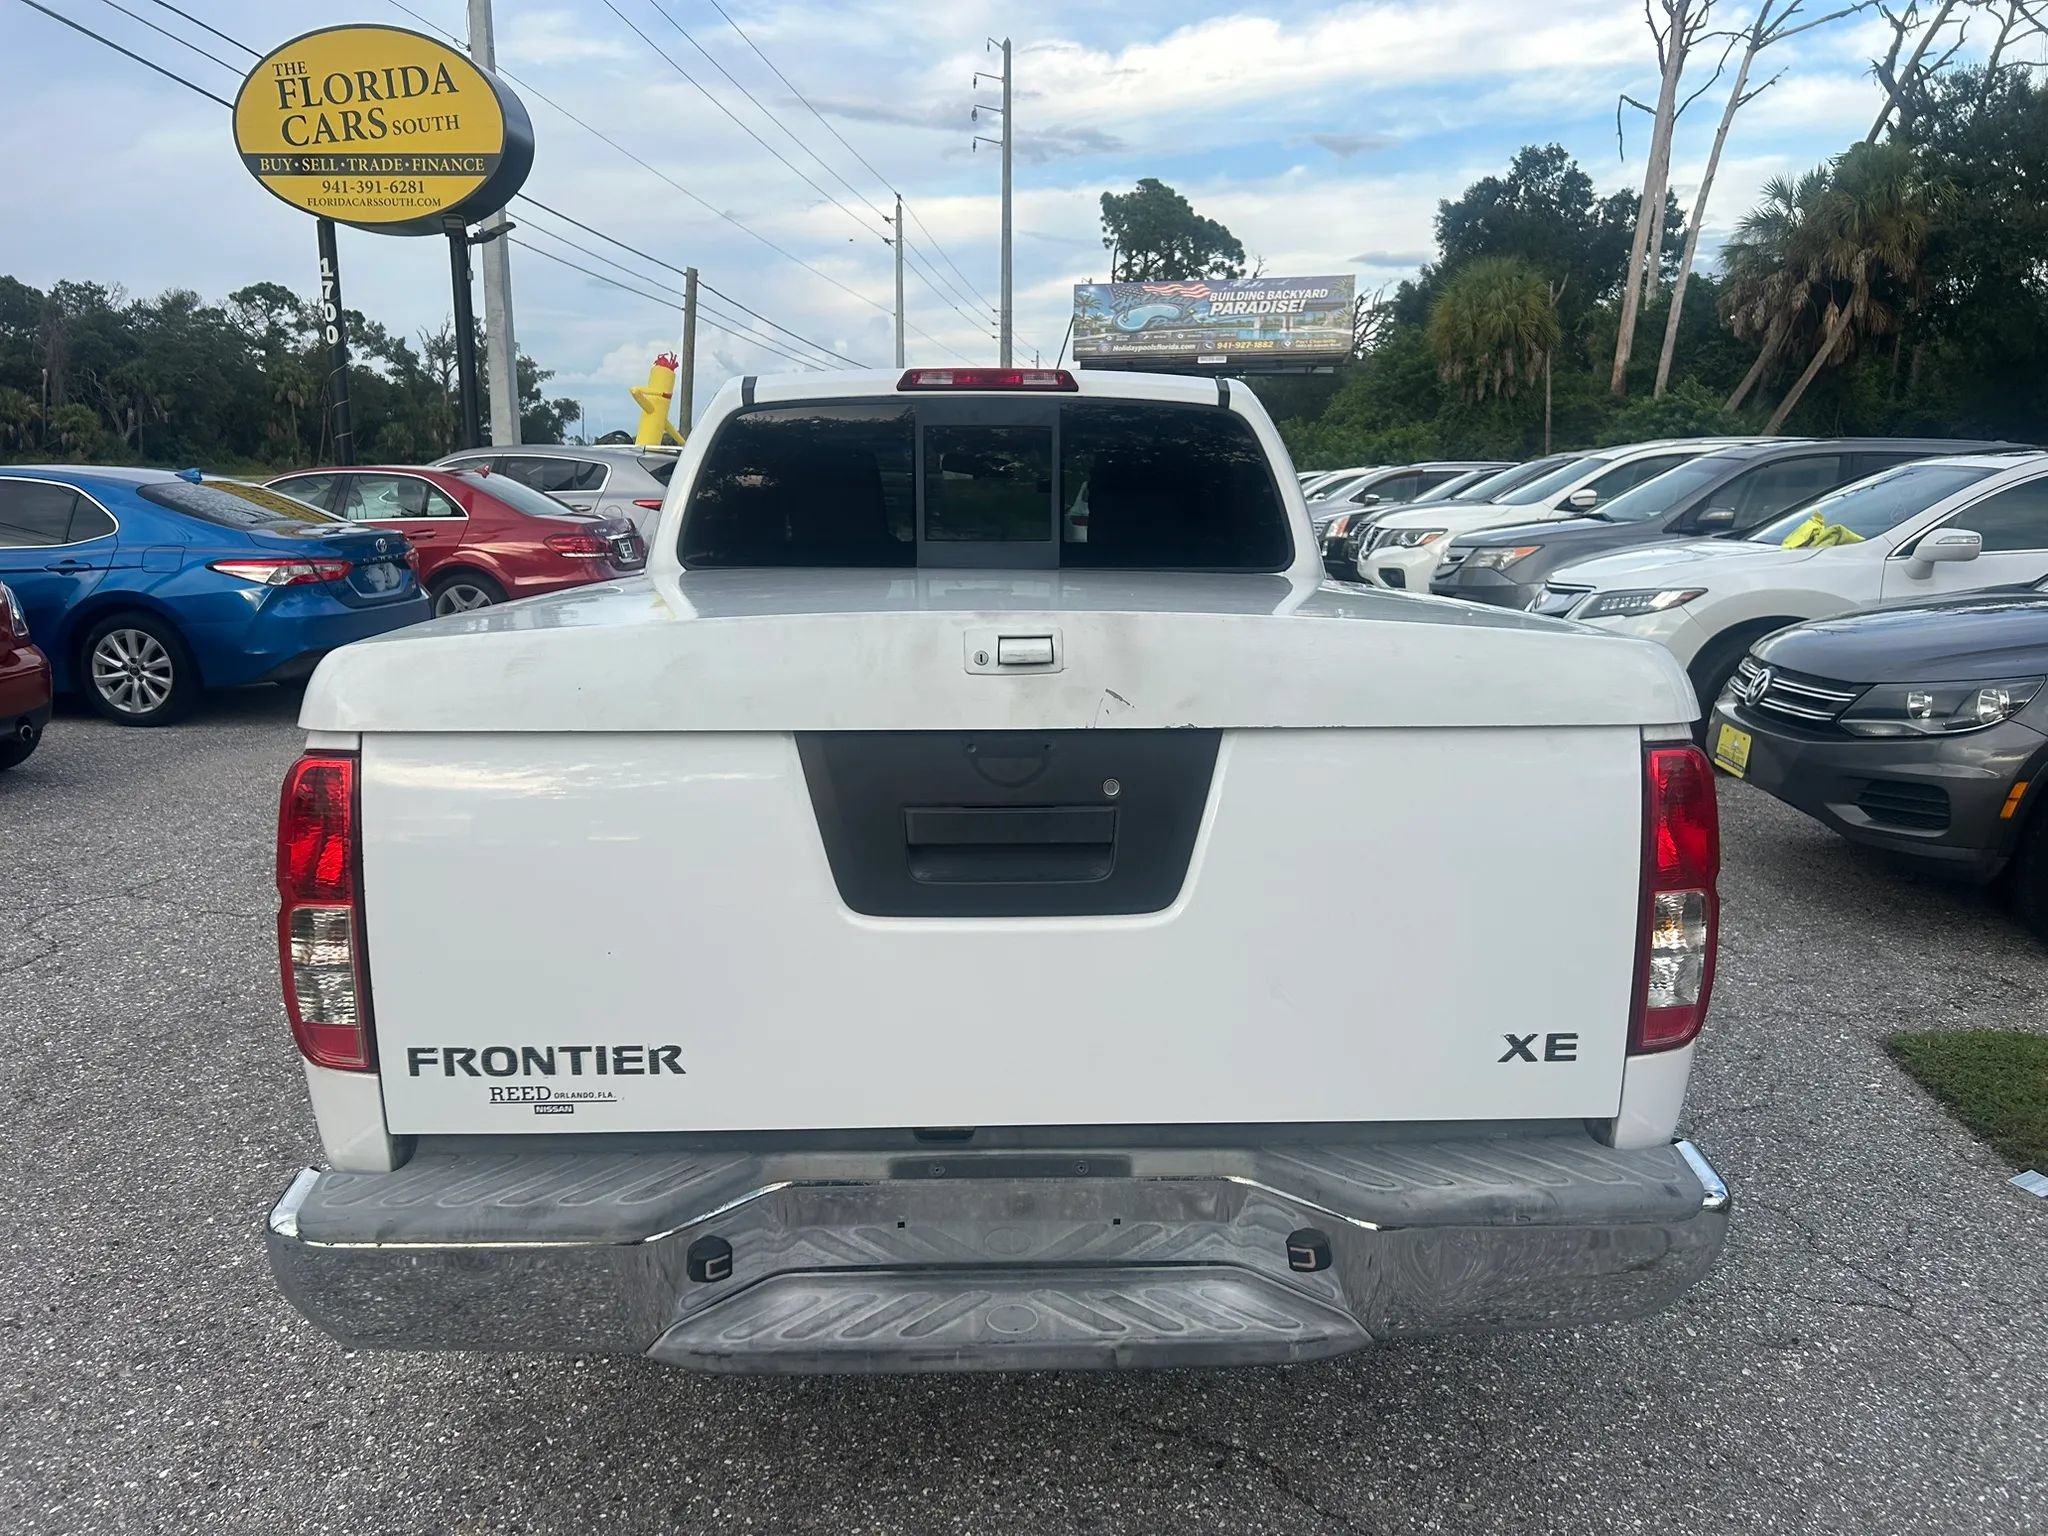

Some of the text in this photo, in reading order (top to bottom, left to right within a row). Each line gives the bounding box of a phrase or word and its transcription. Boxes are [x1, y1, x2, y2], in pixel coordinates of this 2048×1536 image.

[272, 61, 307, 77] THE
[275, 62, 460, 110] FLORIDA
[281, 107, 460, 147] CARS SOUTH
[260, 157, 485, 172] BUY SELL TRADE FINANCE
[322, 180, 425, 194] 941-391-6281
[307, 197, 441, 208] FLORIDACARSSOUTH.COM
[320, 257, 339, 345] 1700
[1209, 288, 1329, 302] BUILDING BACKYARD
[1209, 300, 1305, 316] PARADISE!
[1497, 1033, 1579, 1062] XE
[407, 1045, 687, 1077] FRONTIER
[489, 1086, 551, 1101] REED
[535, 1105, 573, 1114] NISSAN
